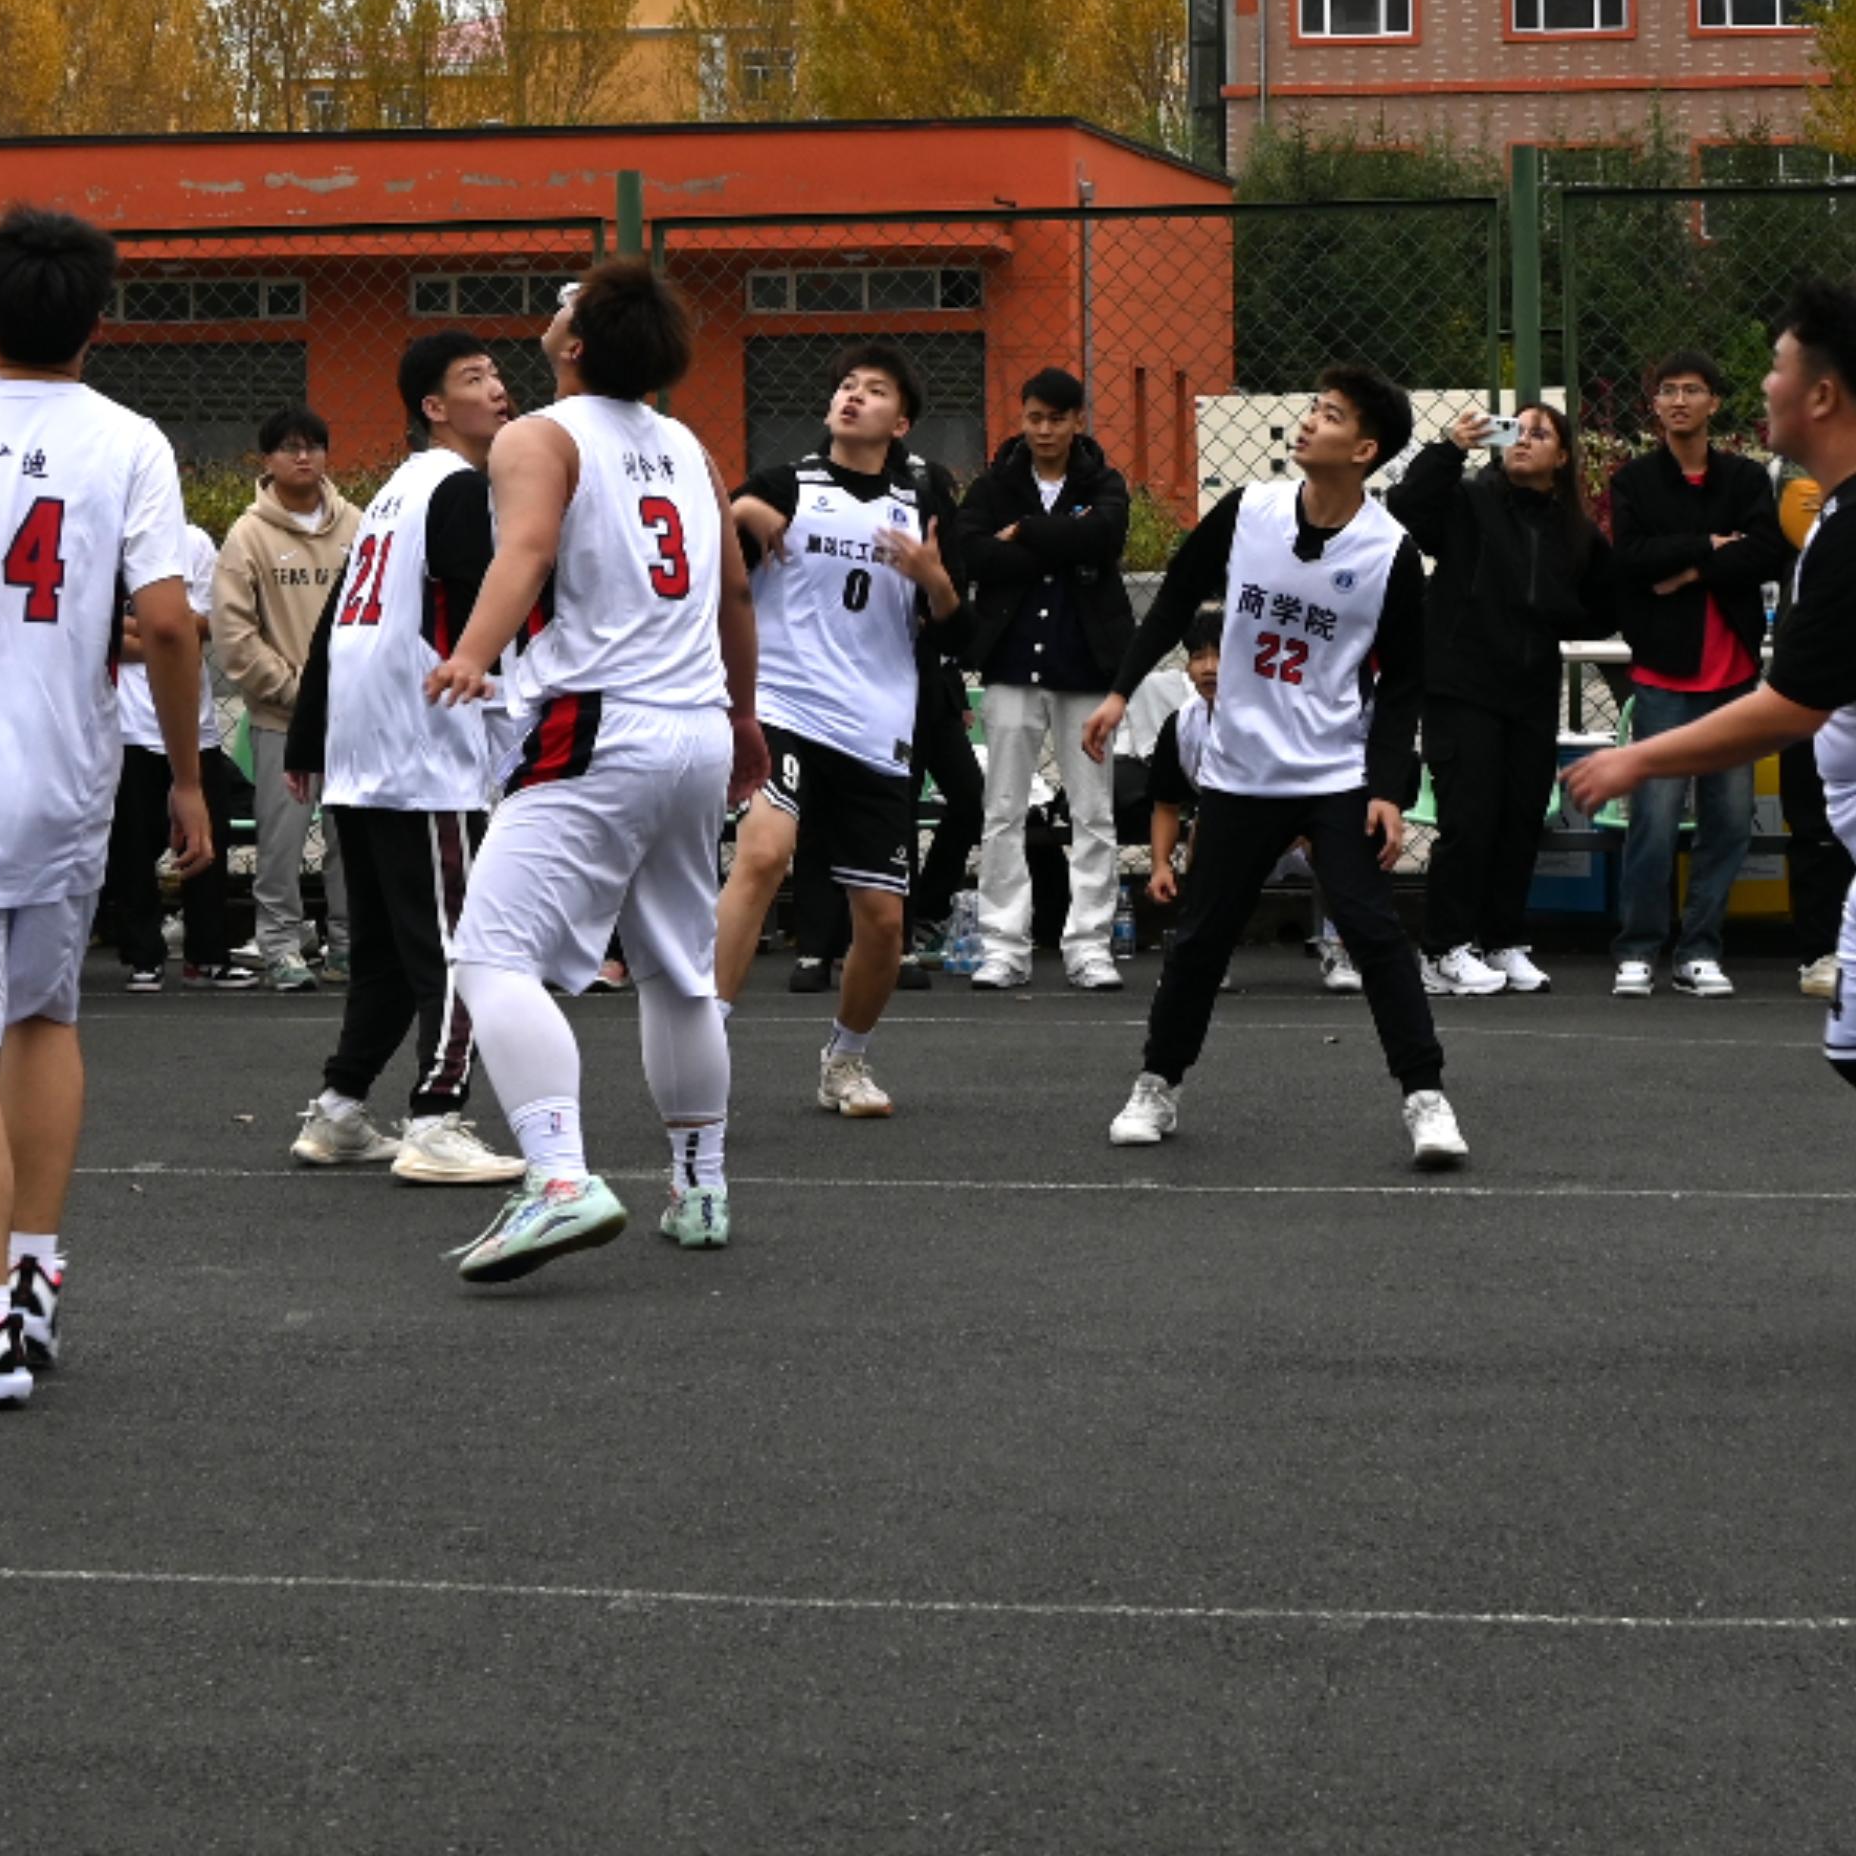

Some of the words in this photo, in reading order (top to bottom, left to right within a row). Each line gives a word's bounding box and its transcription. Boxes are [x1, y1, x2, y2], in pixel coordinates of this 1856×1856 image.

[639, 495, 690, 601] 3
[338, 530, 394, 627] 21
[842, 567, 872, 613] 0
[1236, 581, 1338, 642] 商学院
[1253, 630, 1310, 685] 22
[782, 753, 800, 793] 9
